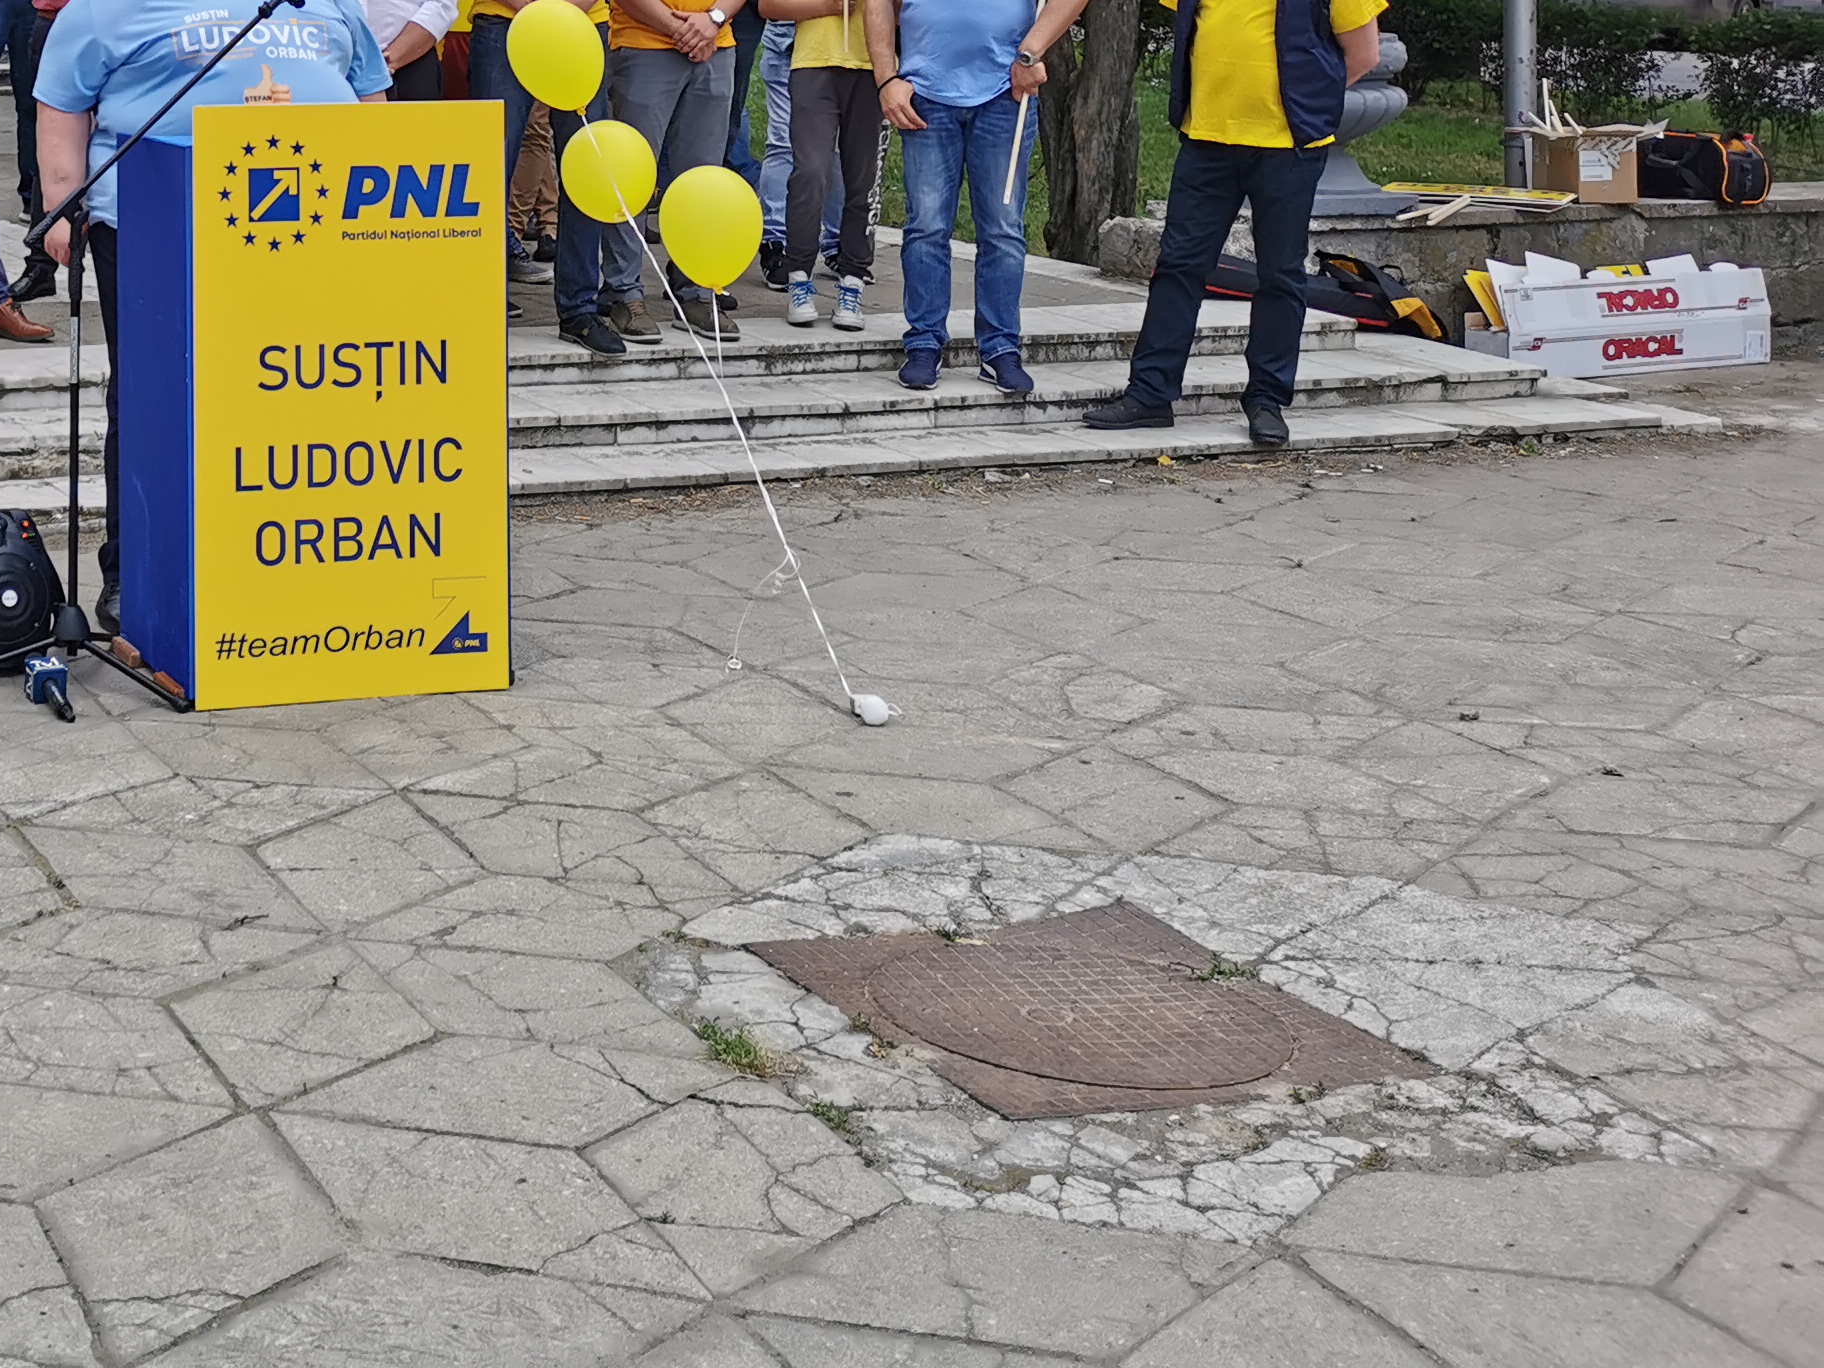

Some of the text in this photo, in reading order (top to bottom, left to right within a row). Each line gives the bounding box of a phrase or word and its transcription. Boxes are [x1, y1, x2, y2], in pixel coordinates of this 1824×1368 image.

[266, 46, 318, 62] ORBAN
[342, 164, 481, 220] PNL
[341, 227, 482, 242] Partidul Național Liberal
[1602, 334, 1684, 361] ORACAL
[258, 339, 447, 403] SUSȚIN
[235, 437, 464, 493] LUDOVIC
[255, 513, 441, 567] ORBAN
[215, 624, 426, 660] #teamOrban
